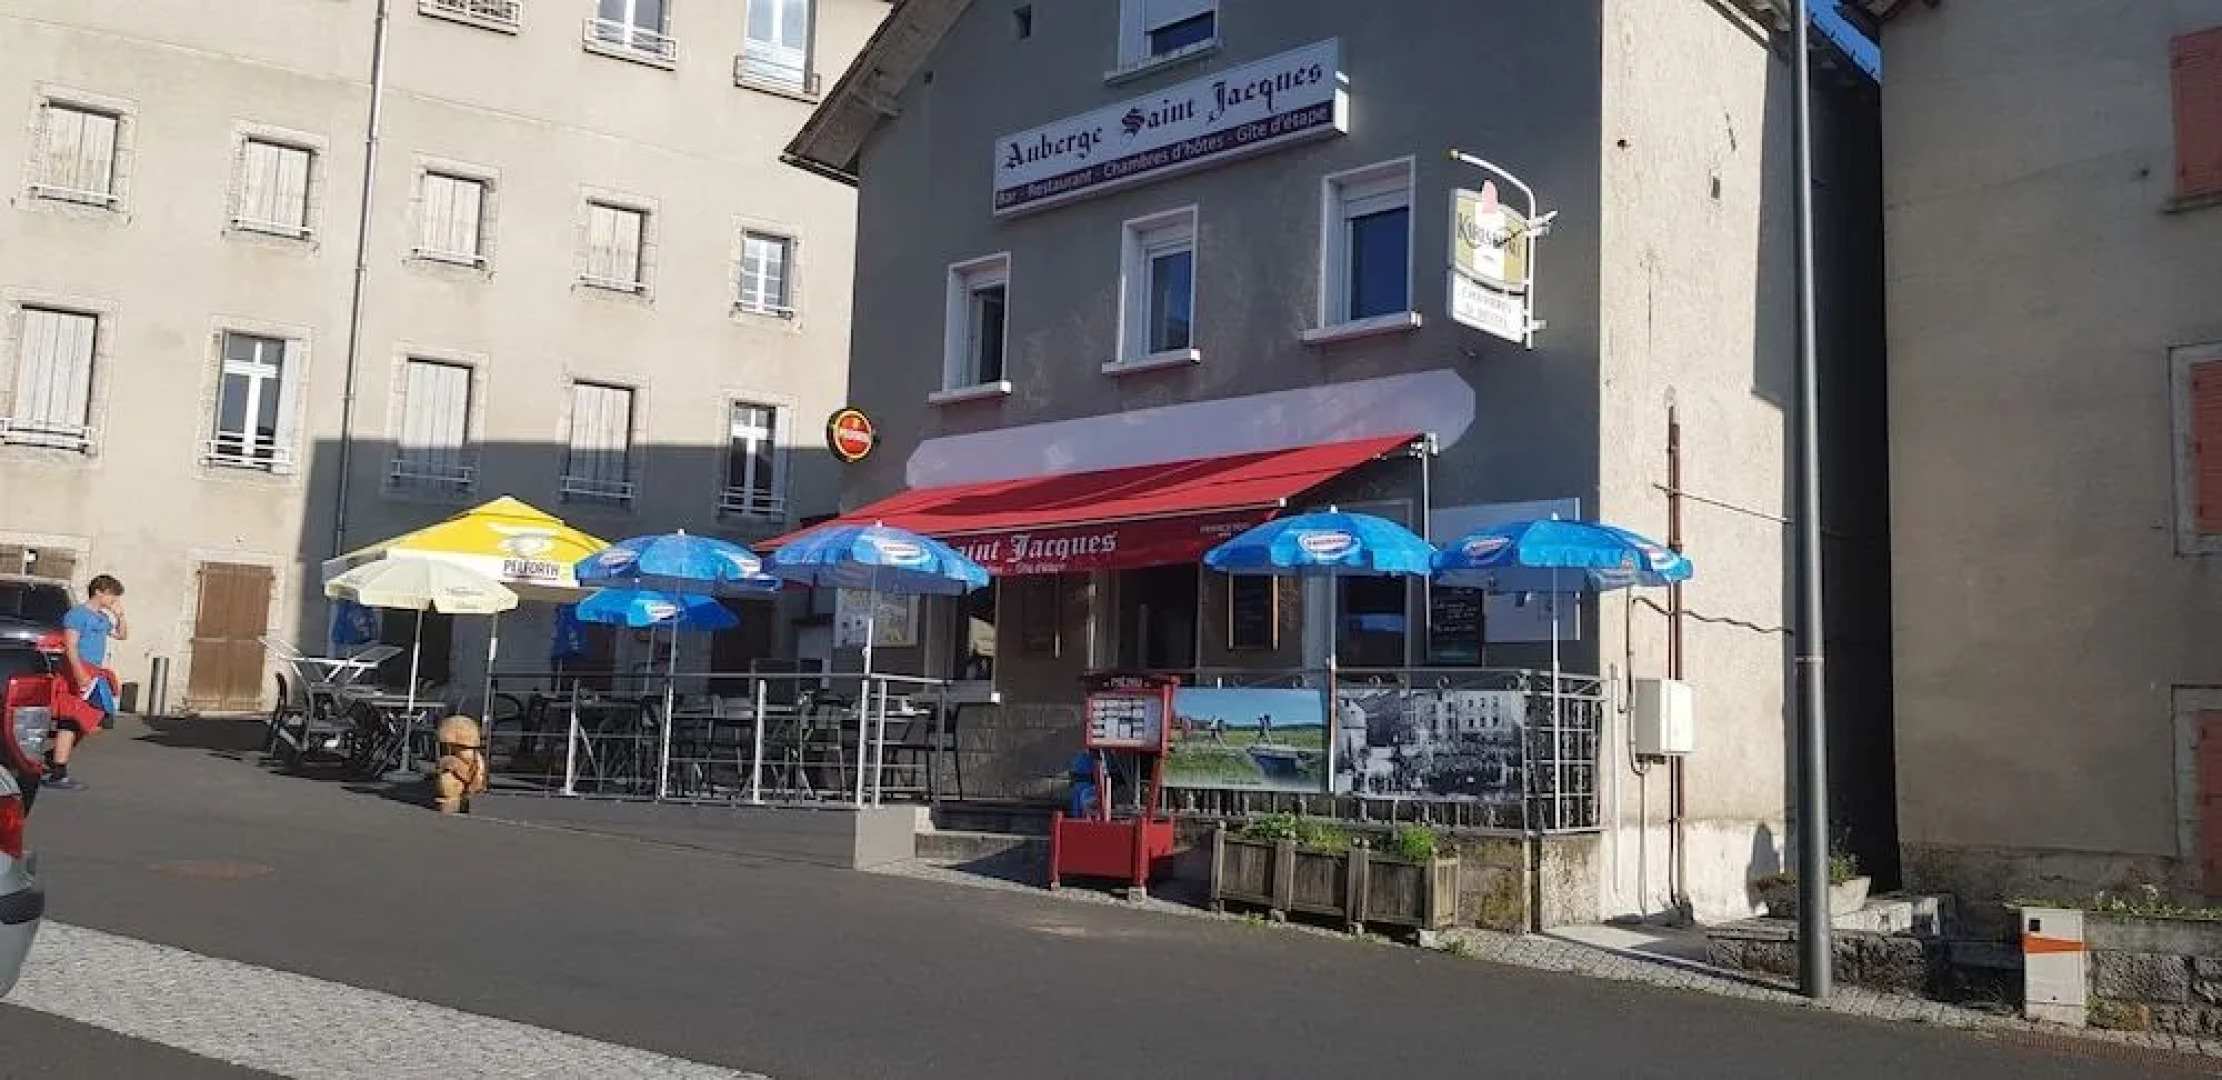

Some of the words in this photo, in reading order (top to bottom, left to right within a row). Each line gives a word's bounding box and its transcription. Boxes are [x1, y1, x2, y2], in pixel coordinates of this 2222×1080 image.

[1003, 126, 1102, 170] Auberge
[1121, 98, 1196, 140] Saint
[1206, 62, 1323, 125] Jacques
[1028, 171, 1093, 199] Restaurant
[1103, 151, 1170, 179] Chambres
[503, 559, 560, 577] PELFORTH
[1007, 530, 1119, 565] Jacques
